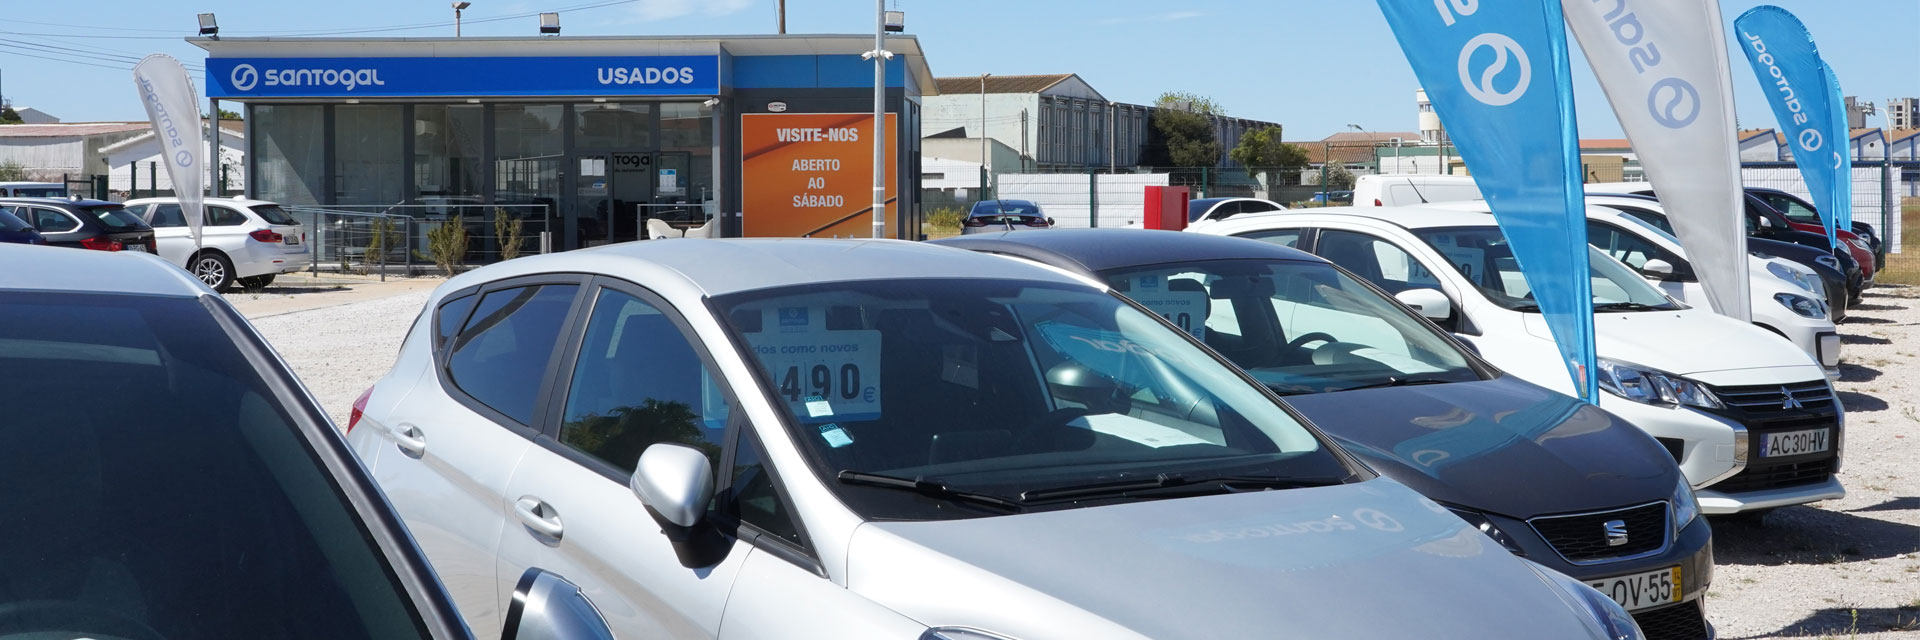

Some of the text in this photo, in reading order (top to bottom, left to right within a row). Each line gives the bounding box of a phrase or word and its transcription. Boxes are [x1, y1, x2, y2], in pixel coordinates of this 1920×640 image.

[597, 67, 694, 84] USADOS
[776, 127, 859, 142] VISITE-NOS
[792, 159, 841, 171] ABERTO
[807, 177, 825, 189] AO
[792, 193, 844, 207] SÁBADO
[780, 344, 817, 354] como
[820, 343, 859, 353] novos
[1769, 431, 1825, 456] AC30HV
